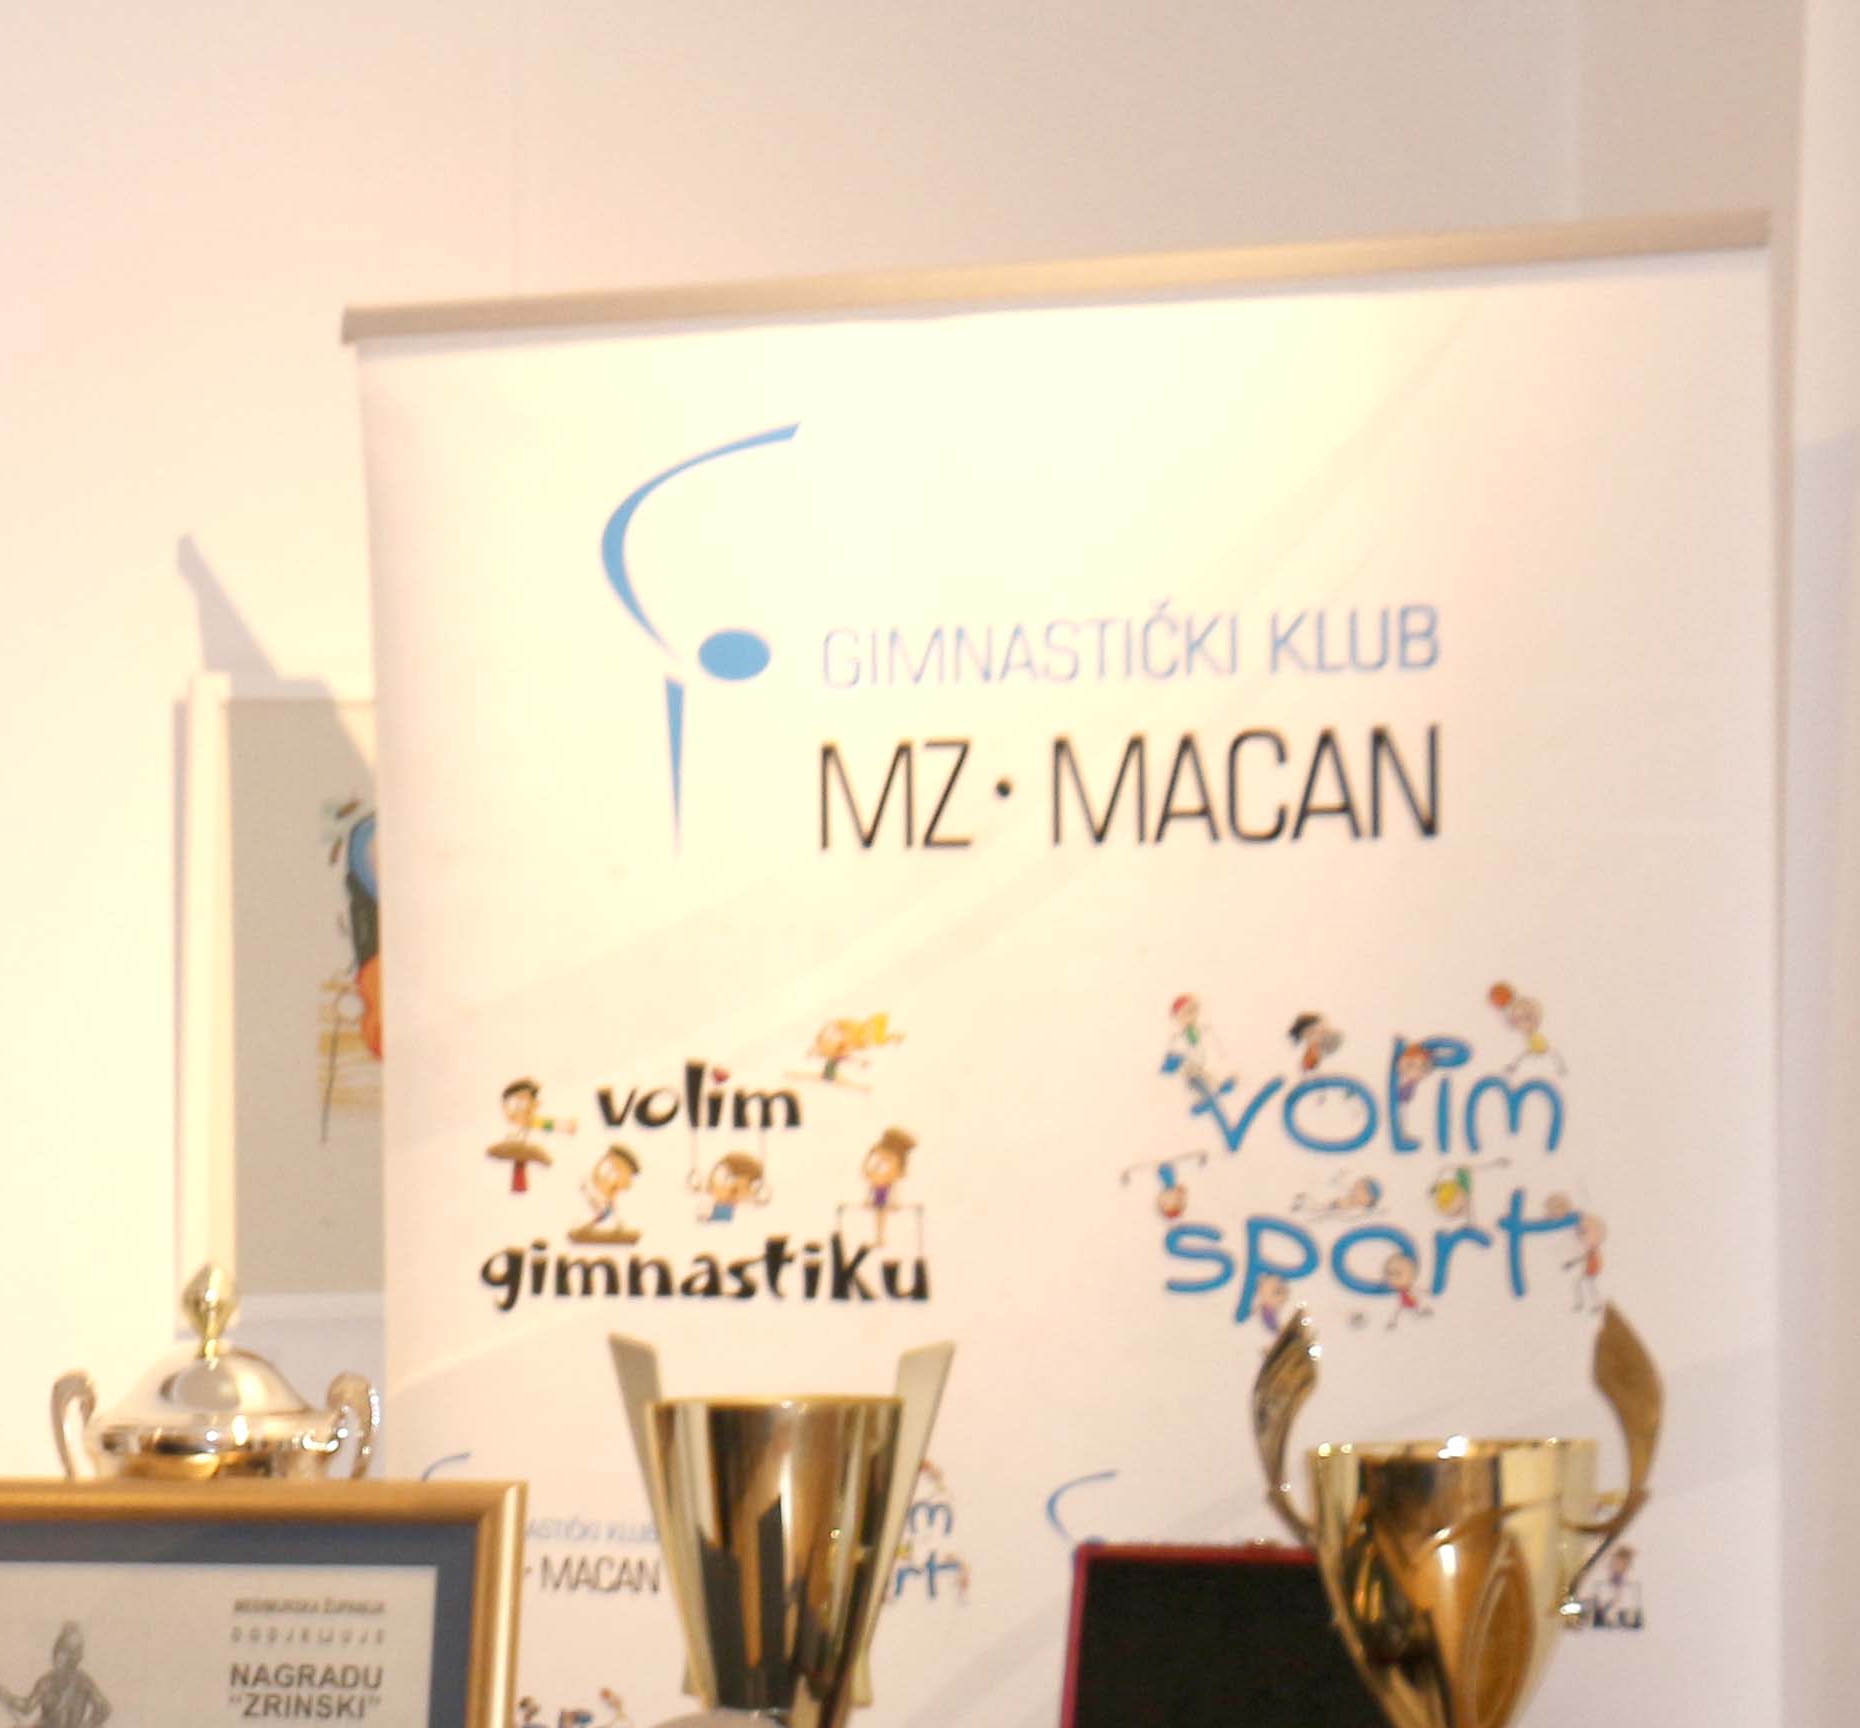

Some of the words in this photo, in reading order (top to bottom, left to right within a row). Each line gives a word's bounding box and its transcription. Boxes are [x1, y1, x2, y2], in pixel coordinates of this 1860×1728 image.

[823, 600, 1237, 690] GIMNASTIČKI
[1269, 604, 1441, 676] KLUB
[820, 741, 972, 851] MZ
[1051, 724, 1442, 847] MACAN
[597, 1062, 802, 1133] volim
[1184, 1038, 1564, 1156] volim
[480, 1238, 931, 1310] gimnastiku
[1165, 1190, 1577, 1322] sport
[541, 1554, 661, 1594] MACAN
[229, 1662, 384, 1690] NAGRADU
